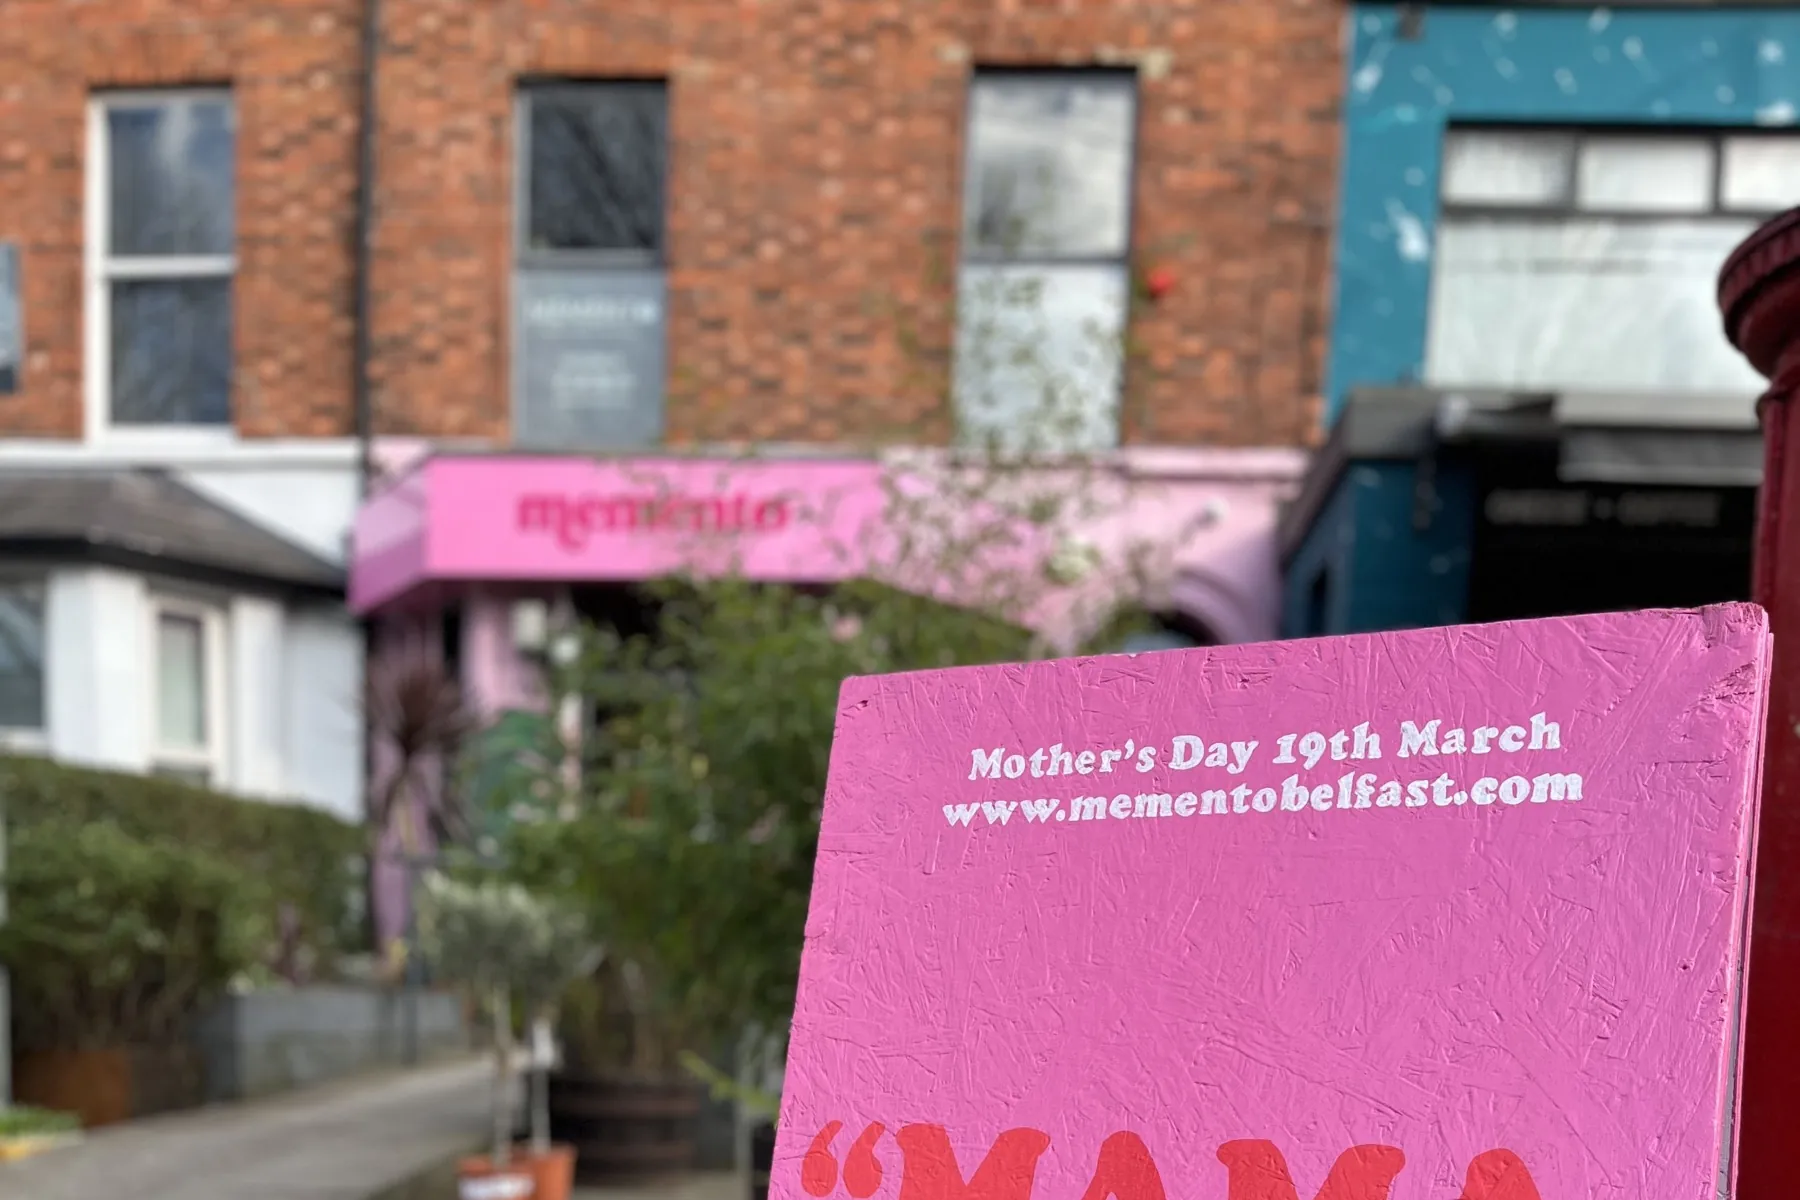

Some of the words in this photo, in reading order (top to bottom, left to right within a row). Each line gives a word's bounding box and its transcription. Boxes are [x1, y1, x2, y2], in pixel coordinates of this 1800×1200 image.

[516, 492, 791, 554] memento
[967, 737, 1156, 781] Mother’s
[1168, 734, 1260, 775] Day
[1272, 720, 1383, 771] 19th
[1396, 711, 1561, 759] March
[942, 770, 1584, 827] www.mementobelfast.com
